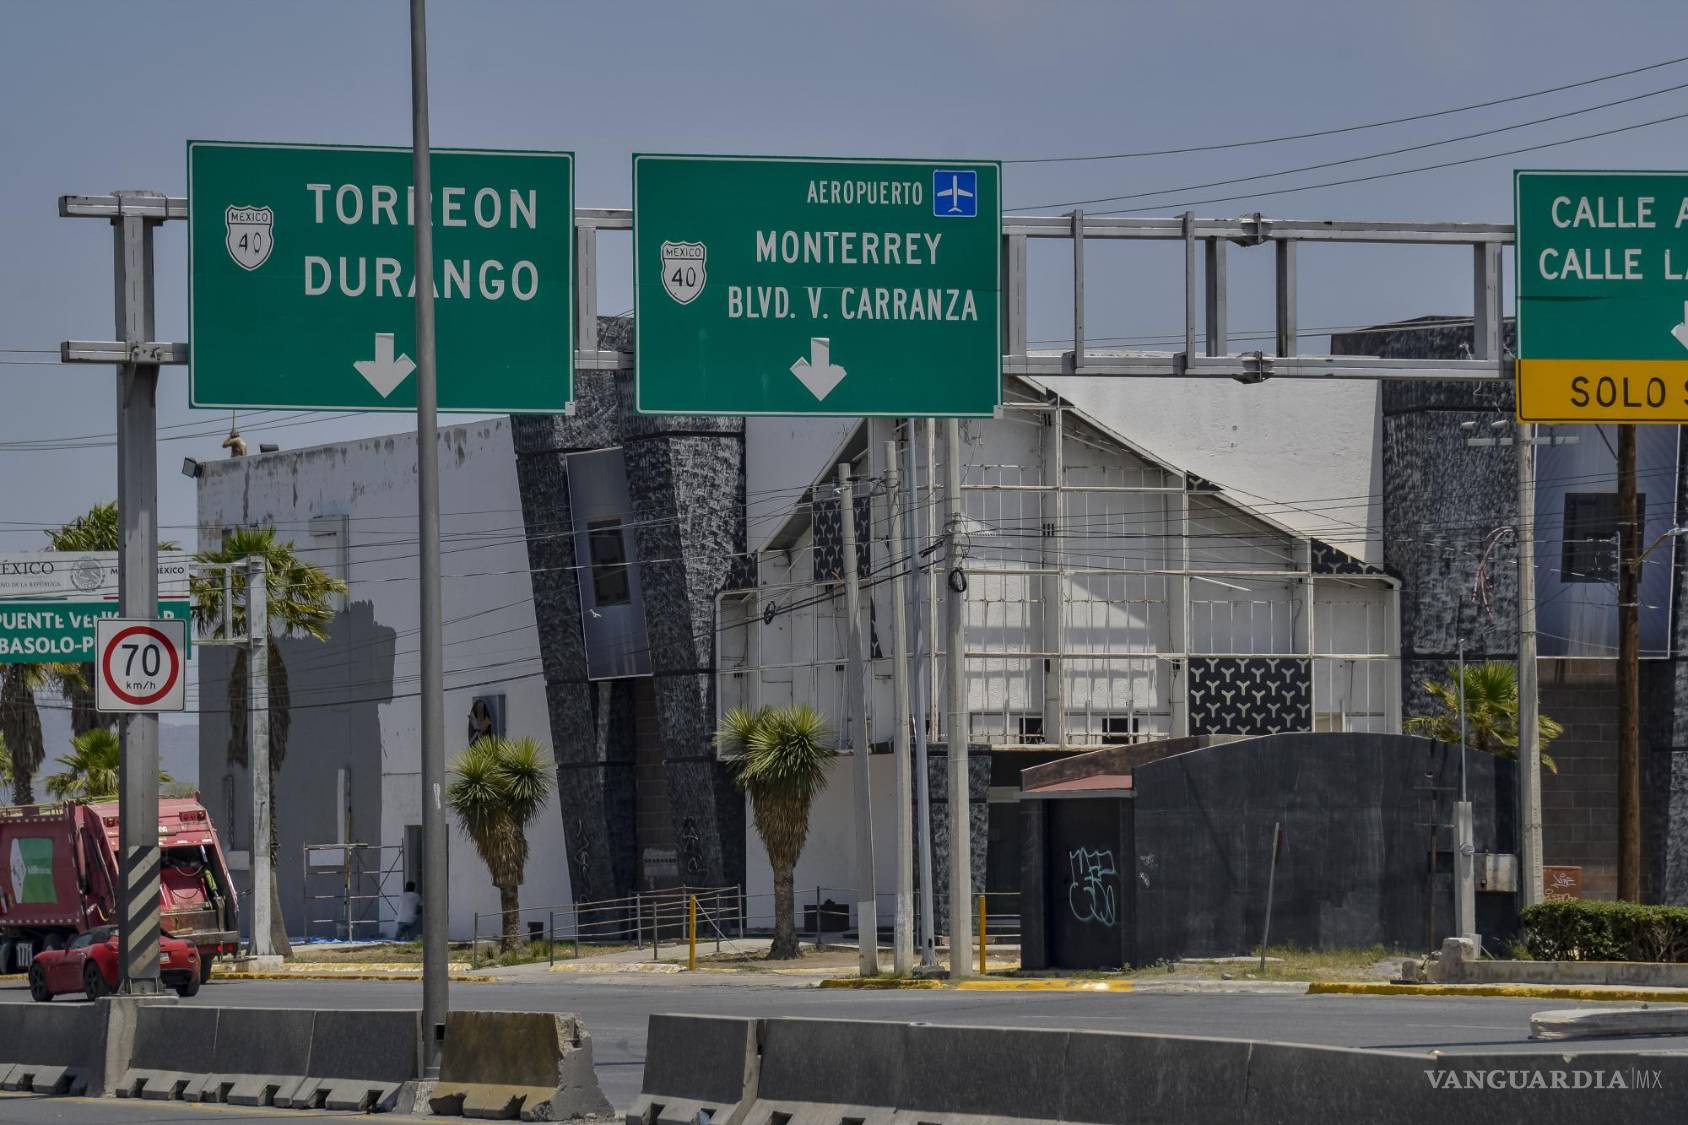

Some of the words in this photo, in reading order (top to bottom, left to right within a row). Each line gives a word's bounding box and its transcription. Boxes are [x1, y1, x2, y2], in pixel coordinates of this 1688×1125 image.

[807, 180, 923, 205] AEROPUERTO
[231, 212, 268, 222] MEXICO
[1551, 196, 1656, 228] CALLE
[238, 232, 262, 254] 40
[666, 247, 702, 257] MEXICO
[756, 230, 942, 265] MONTERREY
[671, 266, 696, 287] 40
[1539, 248, 1643, 280] CALLE
[1664, 249, 1688, 280] L
[728, 286, 796, 319] BLVD.
[807, 286, 829, 319] V.
[841, 287, 978, 321] CARRANZA
[1570, 376, 1666, 408] SOLO
[0, 612, 64, 630] UENTE
[121, 644, 161, 677] 70
[126, 681, 156, 690] km/h
